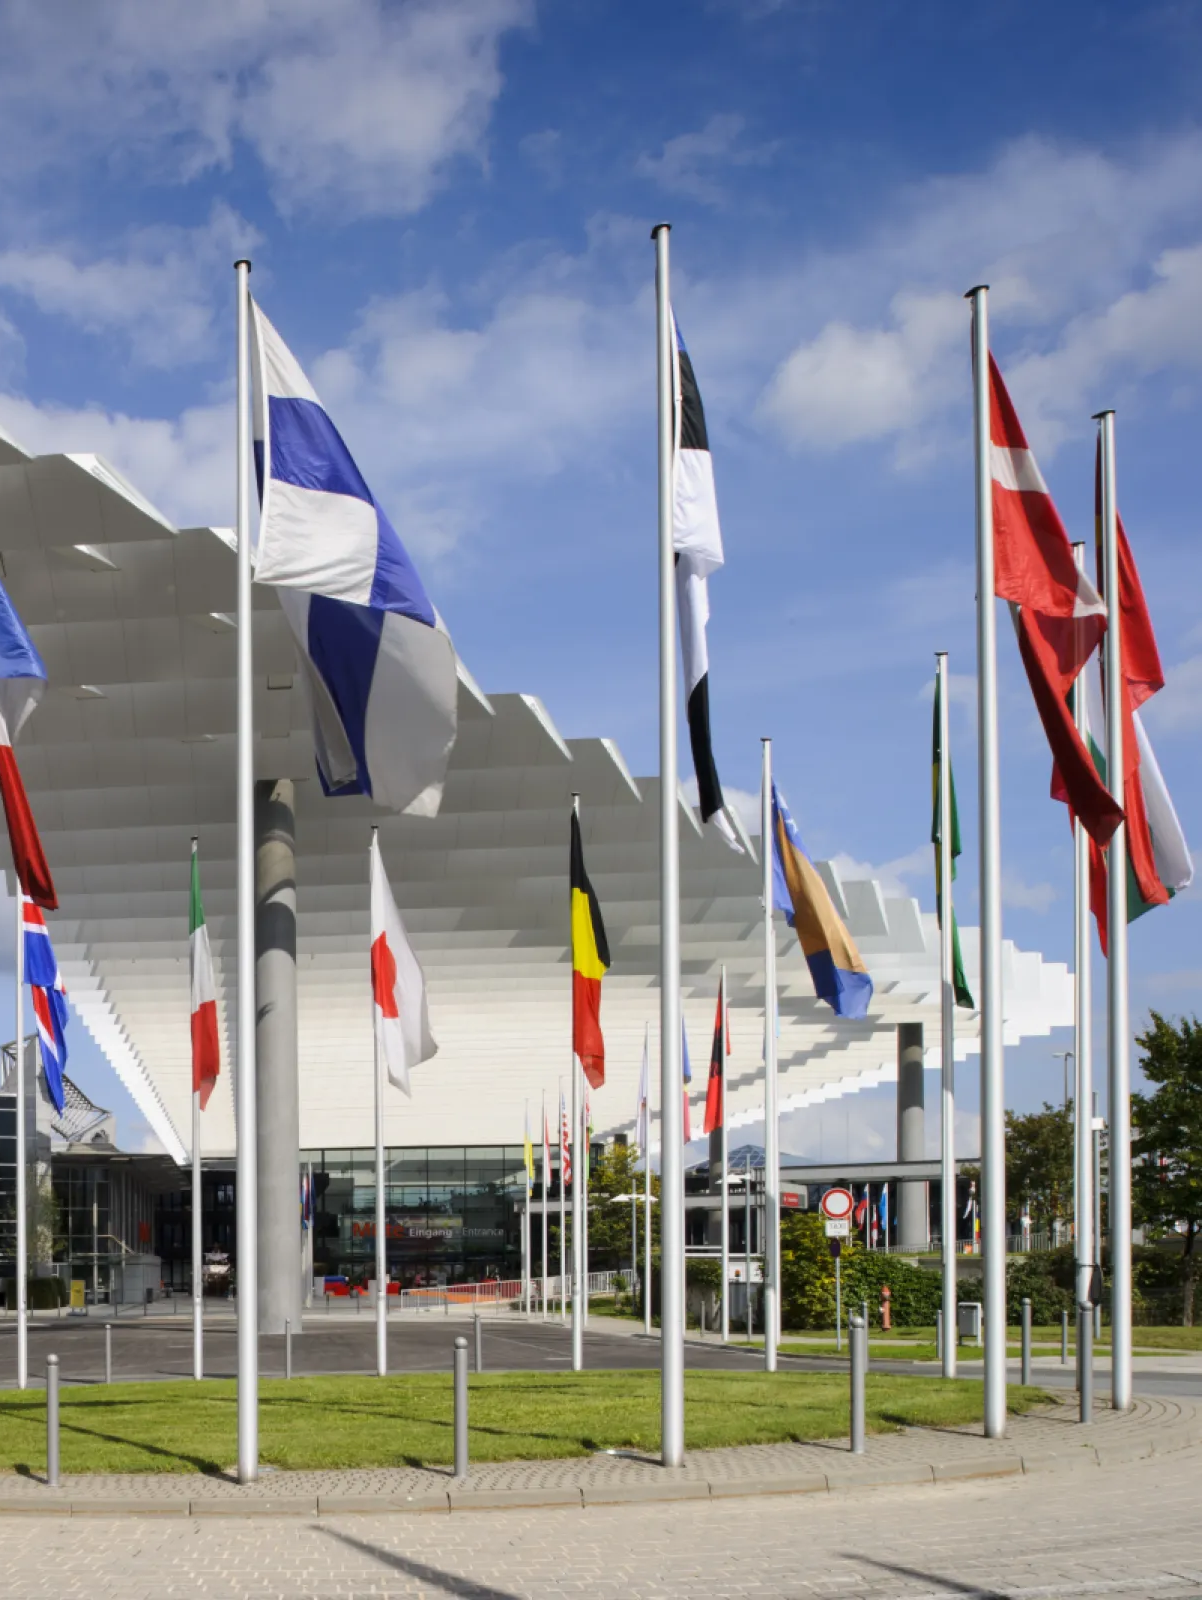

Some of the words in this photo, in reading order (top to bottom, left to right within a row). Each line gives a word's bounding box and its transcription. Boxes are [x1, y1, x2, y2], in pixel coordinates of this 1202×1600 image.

[352, 1222, 406, 1238] Mite
[409, 1227, 453, 1239] Eingang
[462, 1227, 504, 1237] Entrance
